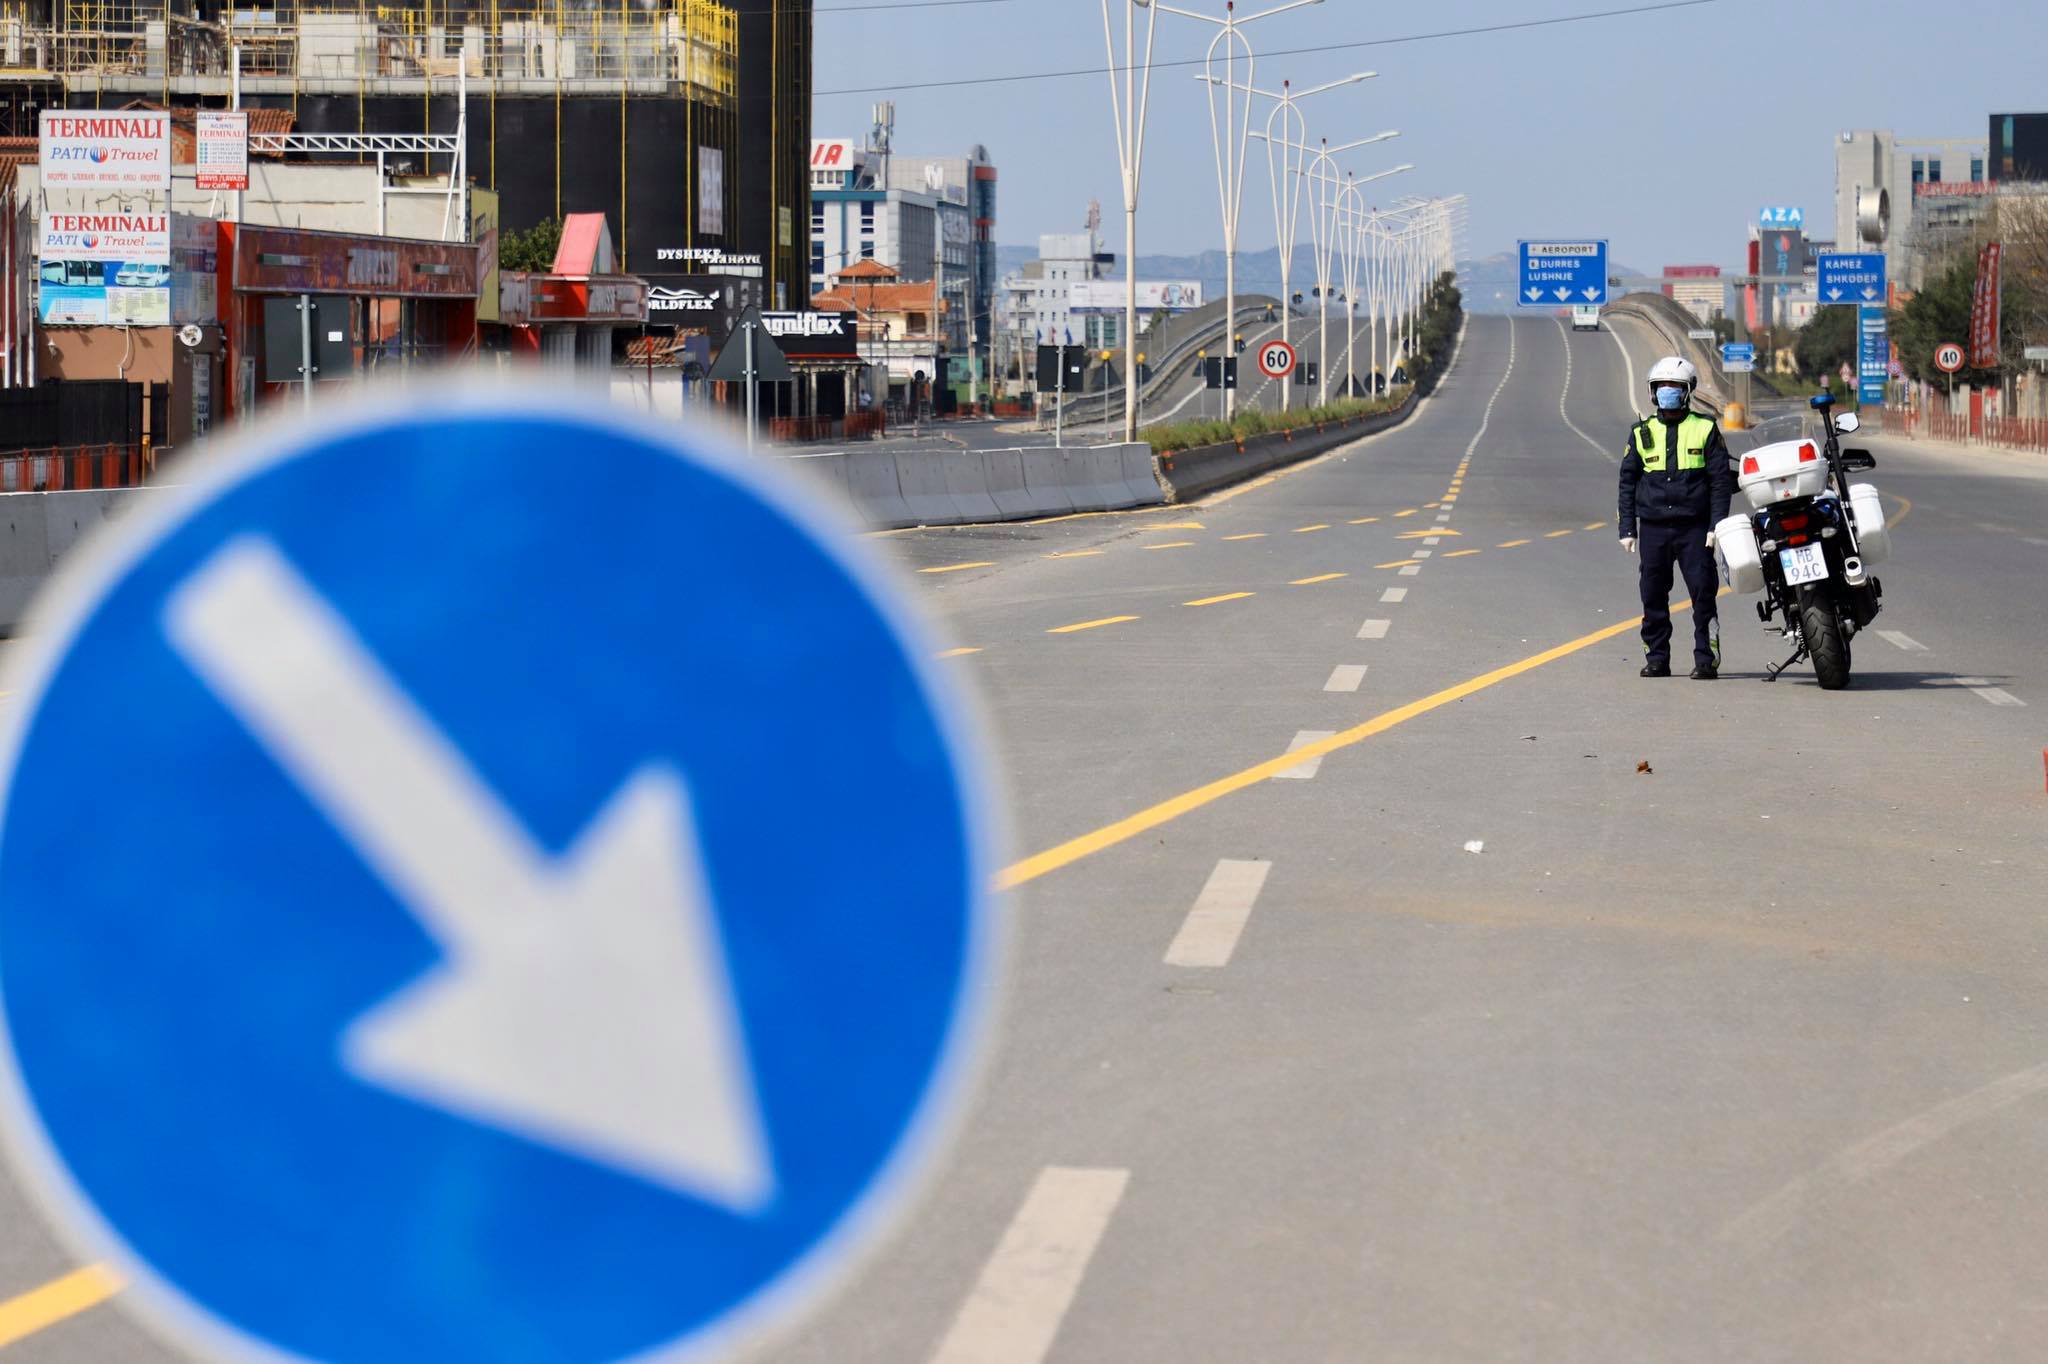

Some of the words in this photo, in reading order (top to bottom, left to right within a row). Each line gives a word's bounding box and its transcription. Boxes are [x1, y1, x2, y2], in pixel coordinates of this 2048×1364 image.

[47, 118, 163, 139] TERMINALI
[200, 130, 246, 138] TERMINALI
[50, 147, 88, 160] PATI
[111, 148, 159, 161] Travel
[1761, 207, 1801, 222] AZA
[49, 215, 167, 232] TERMINALI
[47, 234, 79, 245] PATI
[104, 235, 145, 246] Travel
[657, 248, 721, 260] DYSHEKE
[1542, 246, 1593, 254] AEROPORT
[1541, 260, 1581, 269] DURRES
[1528, 272, 1573, 281] LUSHNJE
[1826, 273, 1878, 284] SHKODER
[1267, 351, 1287, 367] 60
[1942, 351, 1958, 365] 40
[1791, 563, 1821, 582] 94C
